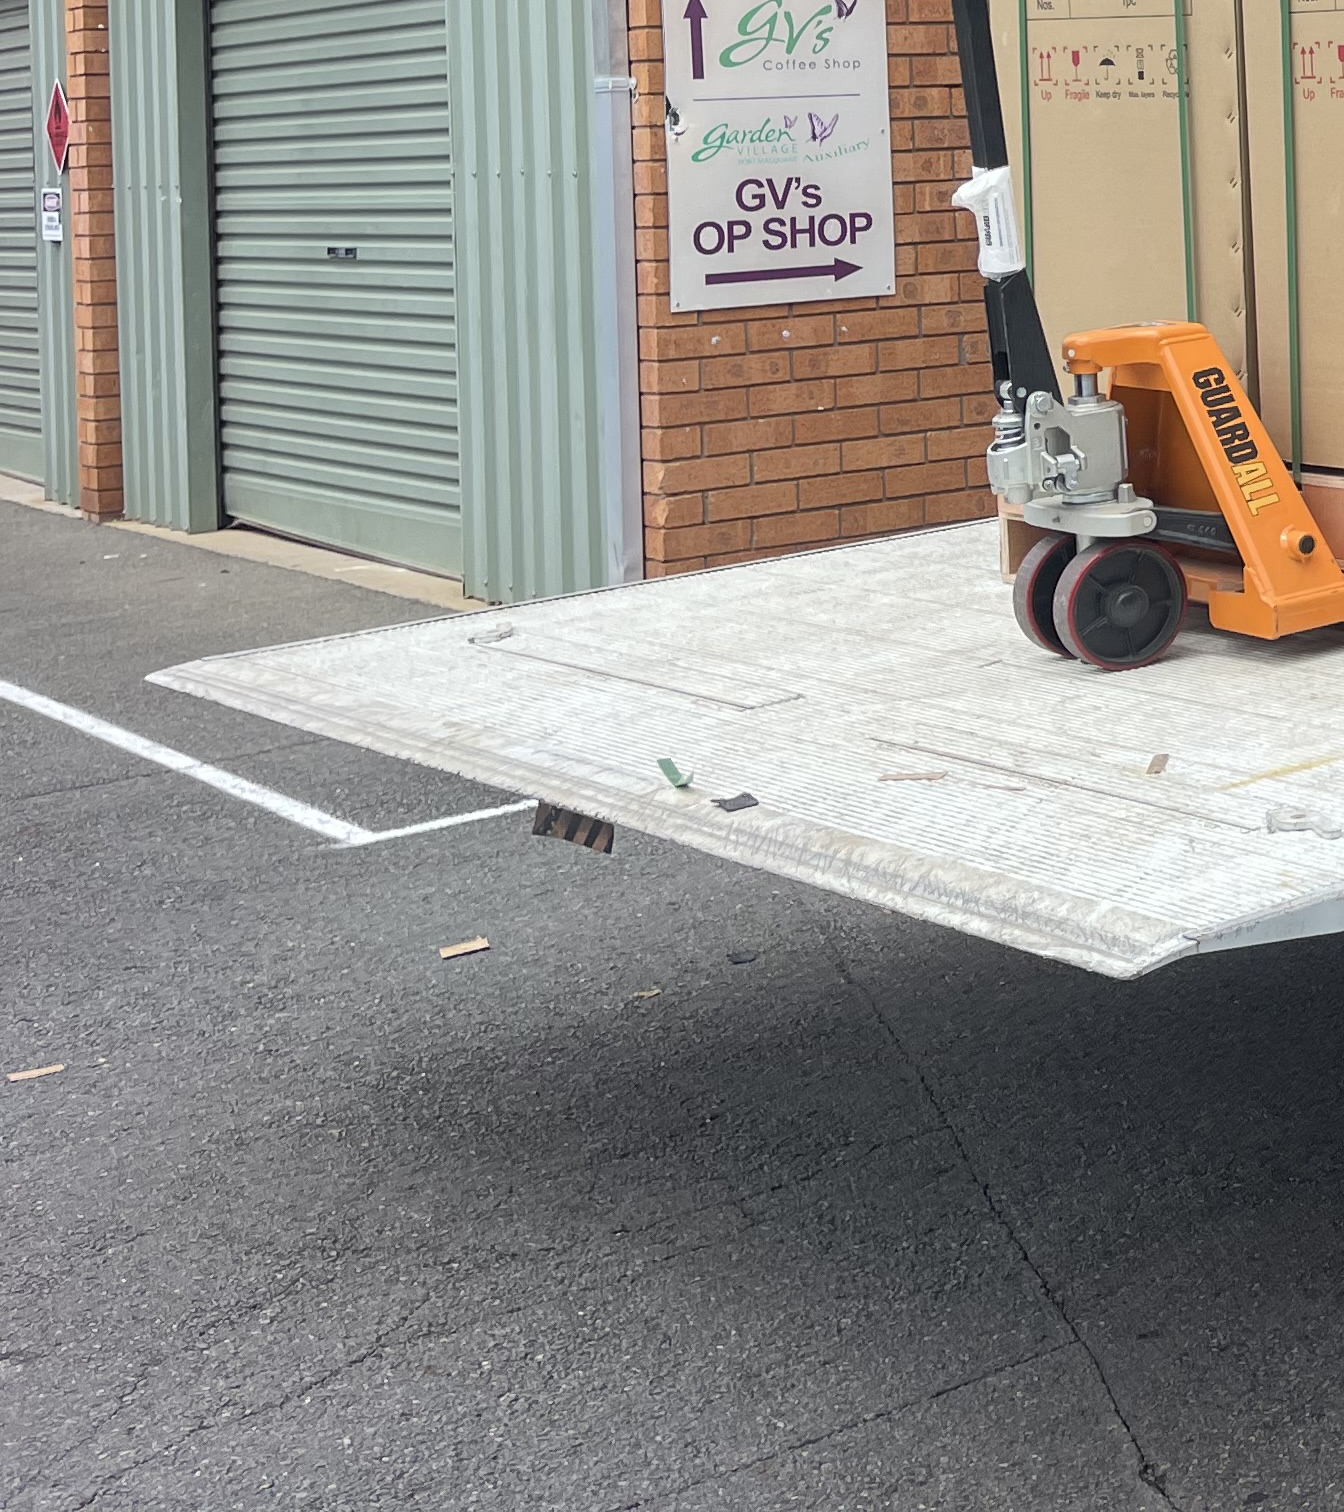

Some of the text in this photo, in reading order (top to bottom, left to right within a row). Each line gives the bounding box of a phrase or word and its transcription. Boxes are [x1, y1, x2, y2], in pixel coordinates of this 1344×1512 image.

[1036, 0, 1055, 10] Nos.
[762, 58, 862, 72] Coffee Shop
[1040, 91, 1052, 102] Up
[1065, 90, 1090, 102] Fragile
[1095, 90, 1111, 99] Keep
[1112, 90, 1121, 100] dry
[1303, 88, 1316, 100] Up
[736, 143, 798, 155] VILLAGE
[802, 137, 871, 163] Auxiliary
[735, 177, 822, 212] GV's
[693, 212, 873, 255] OP SHOP
[1192, 367, 1280, 517] GUARDALL
